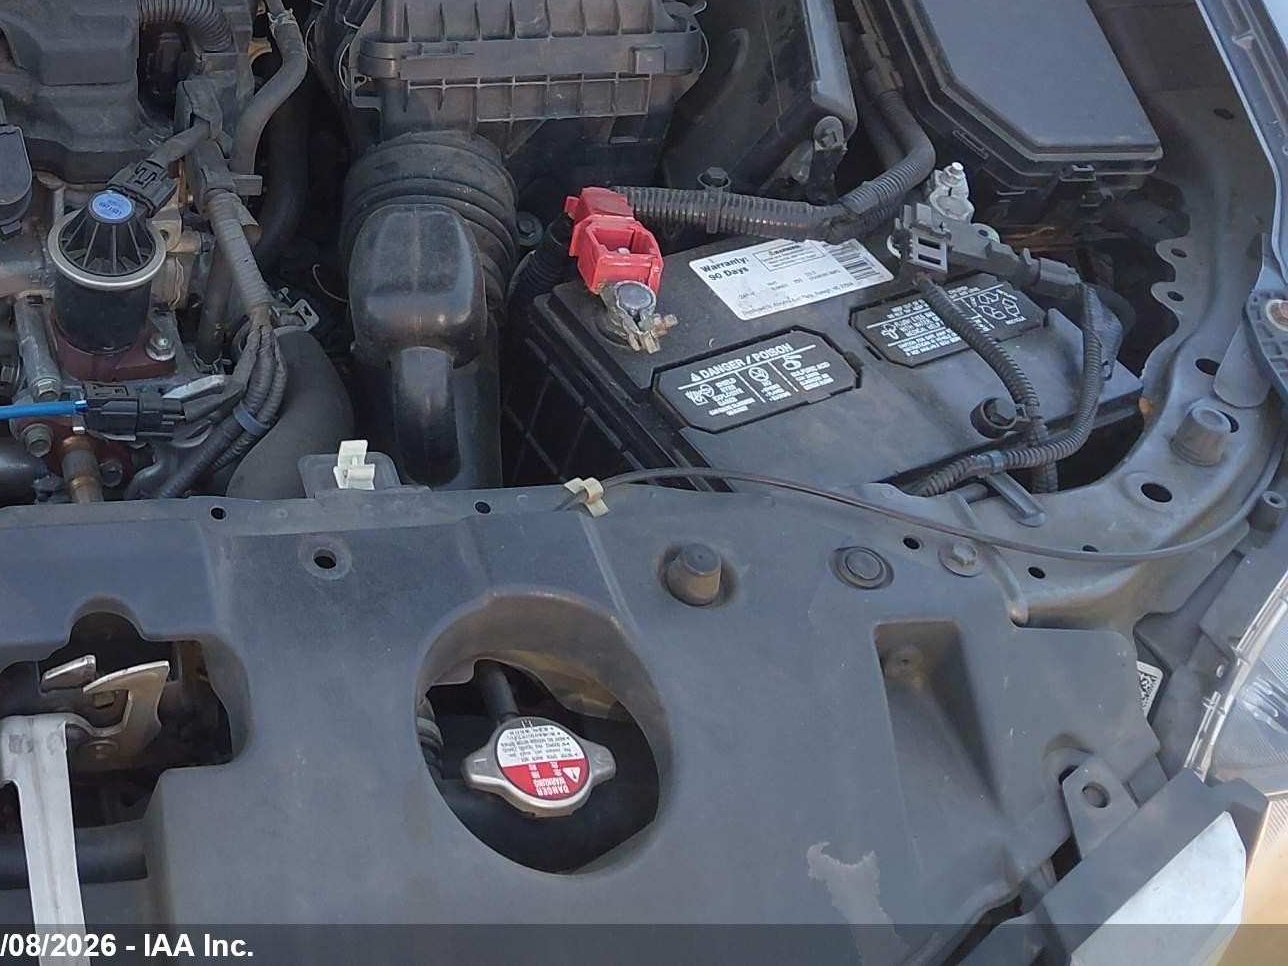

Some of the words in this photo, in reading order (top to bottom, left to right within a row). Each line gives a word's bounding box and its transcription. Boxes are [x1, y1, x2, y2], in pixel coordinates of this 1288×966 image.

[699, 256, 749, 274] Warranty:
[708, 272, 724, 282] 90
[725, 266, 750, 279] Days
[698, 358, 746, 380] DANGER
[751, 342, 794, 363] POISON
